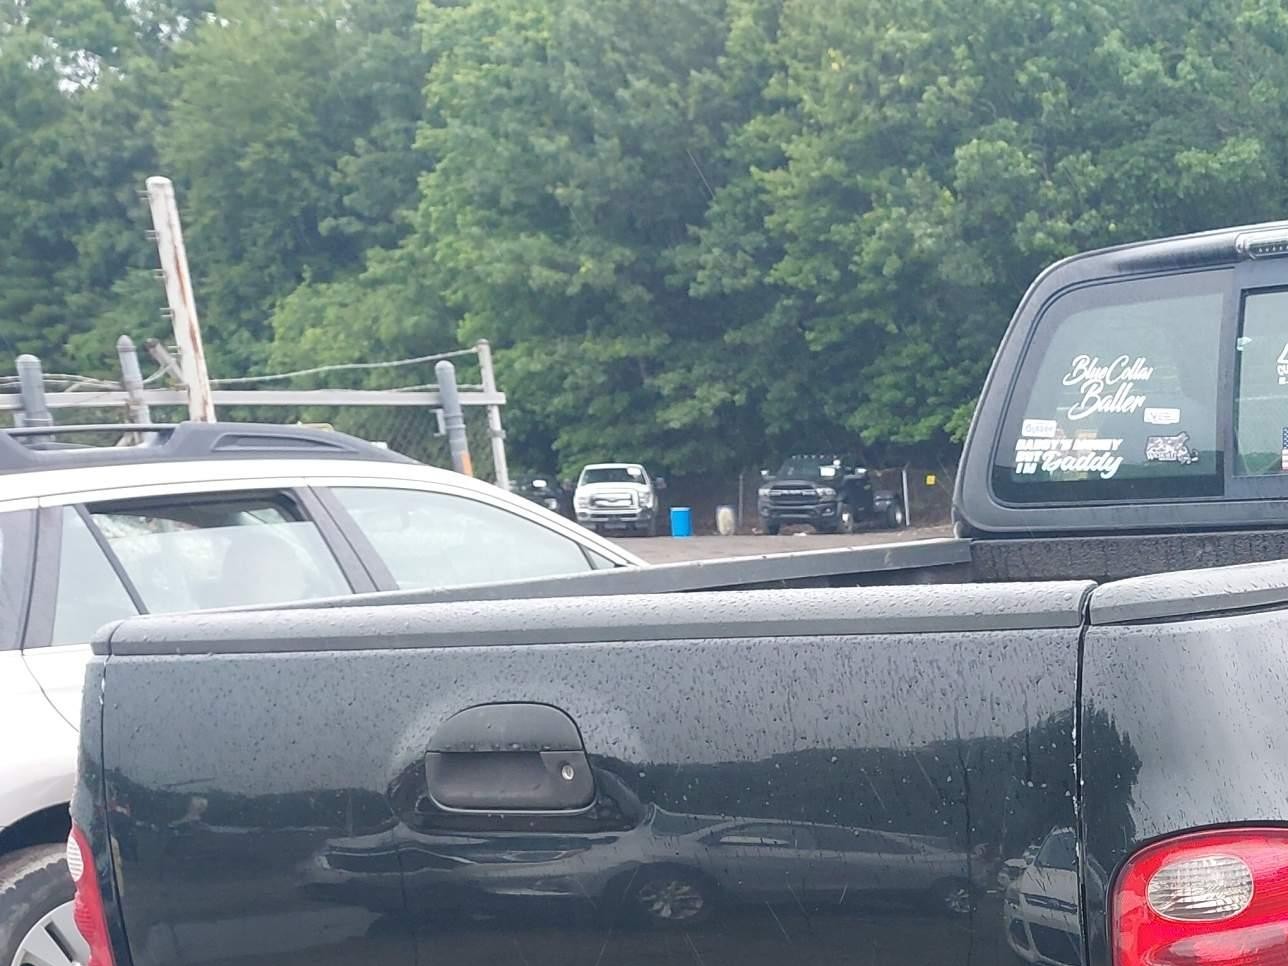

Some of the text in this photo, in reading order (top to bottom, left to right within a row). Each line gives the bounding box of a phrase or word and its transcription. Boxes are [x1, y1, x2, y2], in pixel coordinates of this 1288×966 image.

[1062, 354, 1154, 386] Blue Collar
[1067, 379, 1147, 421] Baller
